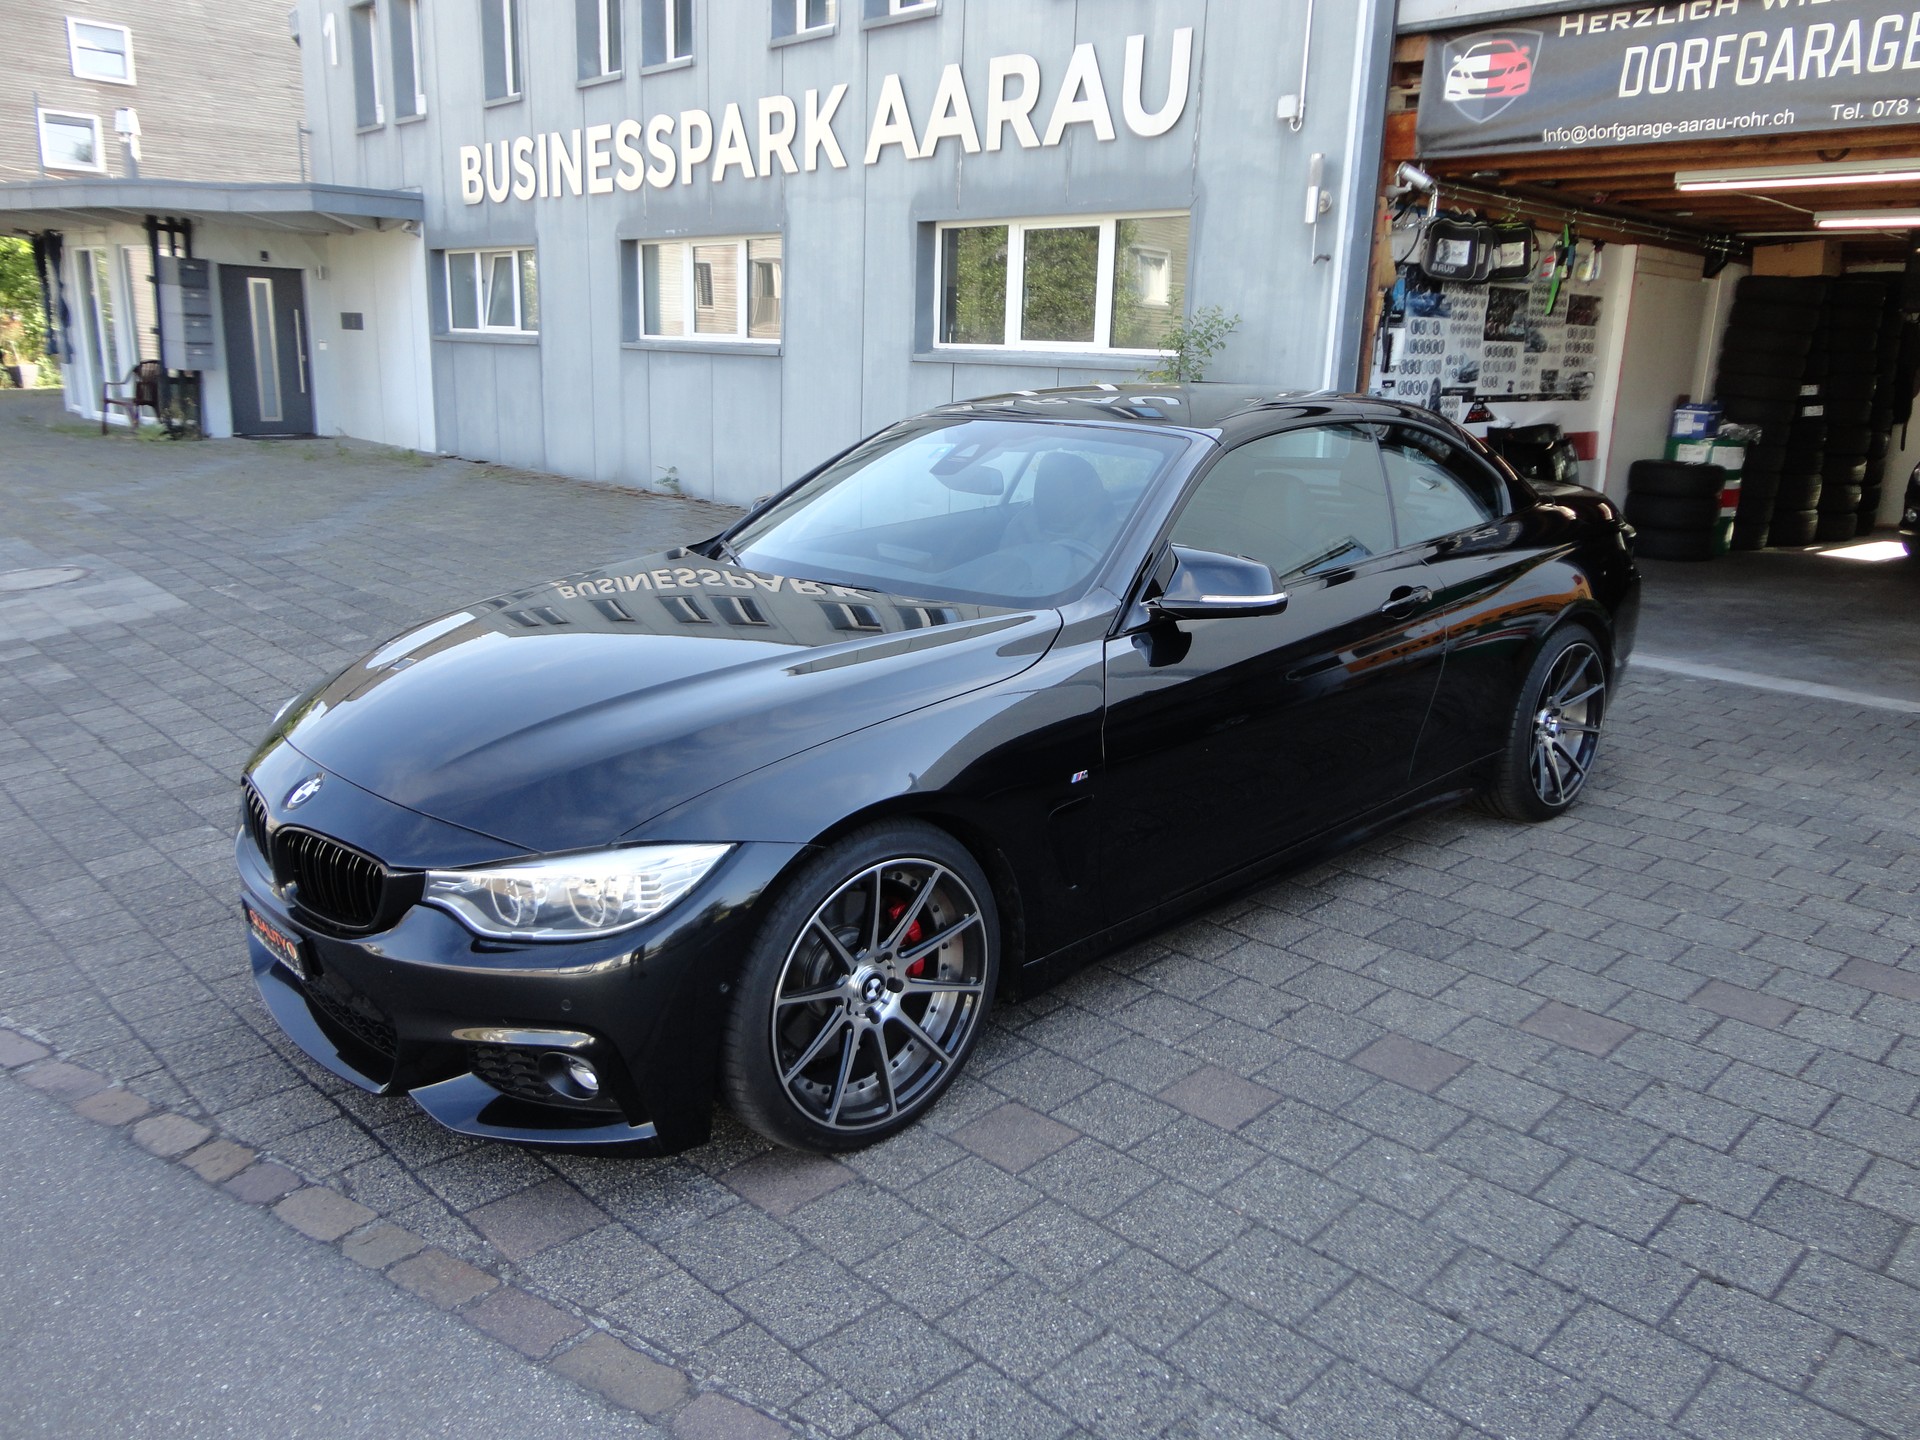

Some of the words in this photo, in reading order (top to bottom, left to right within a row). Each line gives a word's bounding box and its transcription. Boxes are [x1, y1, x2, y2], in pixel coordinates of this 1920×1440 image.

[1558, 0, 1741, 38] HERZLICH
[323, 12, 338, 66] 1
[460, 82, 849, 206] BUSINESSPARK
[863, 26, 1194, 165] AARAU
[1543, 109, 1795, 145] Info@dorfgarage-aarau-rohr.ch
[1830, 102, 1864, 120] Tel.
[1872, 98, 1909, 118] 078
